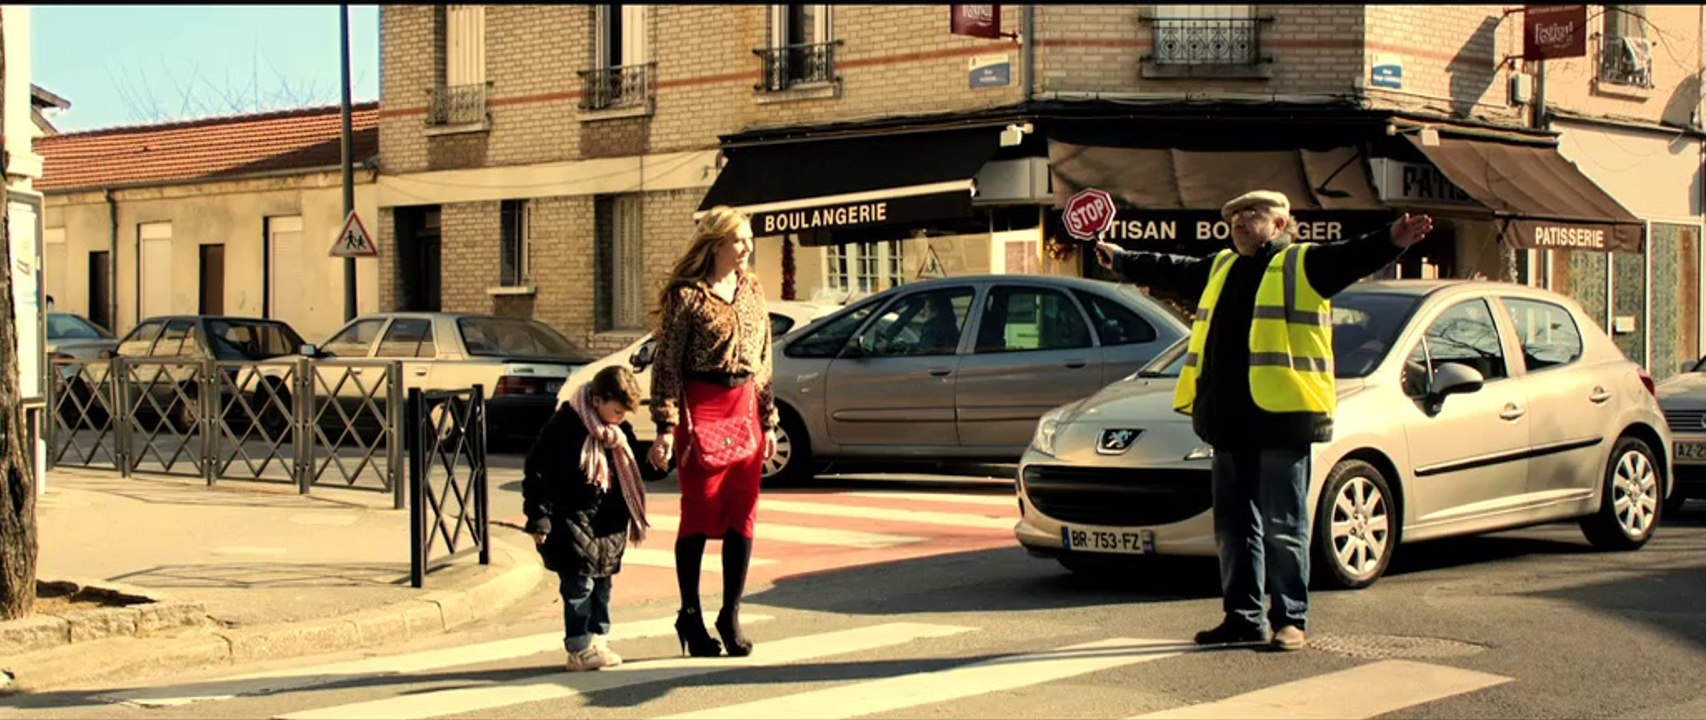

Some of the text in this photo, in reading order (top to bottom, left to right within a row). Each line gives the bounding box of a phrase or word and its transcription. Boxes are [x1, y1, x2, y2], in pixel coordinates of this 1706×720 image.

[765, 203, 887, 232] BOULANGERIE
[1070, 199, 1105, 230] STOP
[1109, 221, 1342, 240] TISAN BOGER
[1535, 226, 1604, 248] PATISSERIE
[1679, 443, 1706, 458] AZ-2
[1072, 529, 1141, 550] BR-753-FZ
